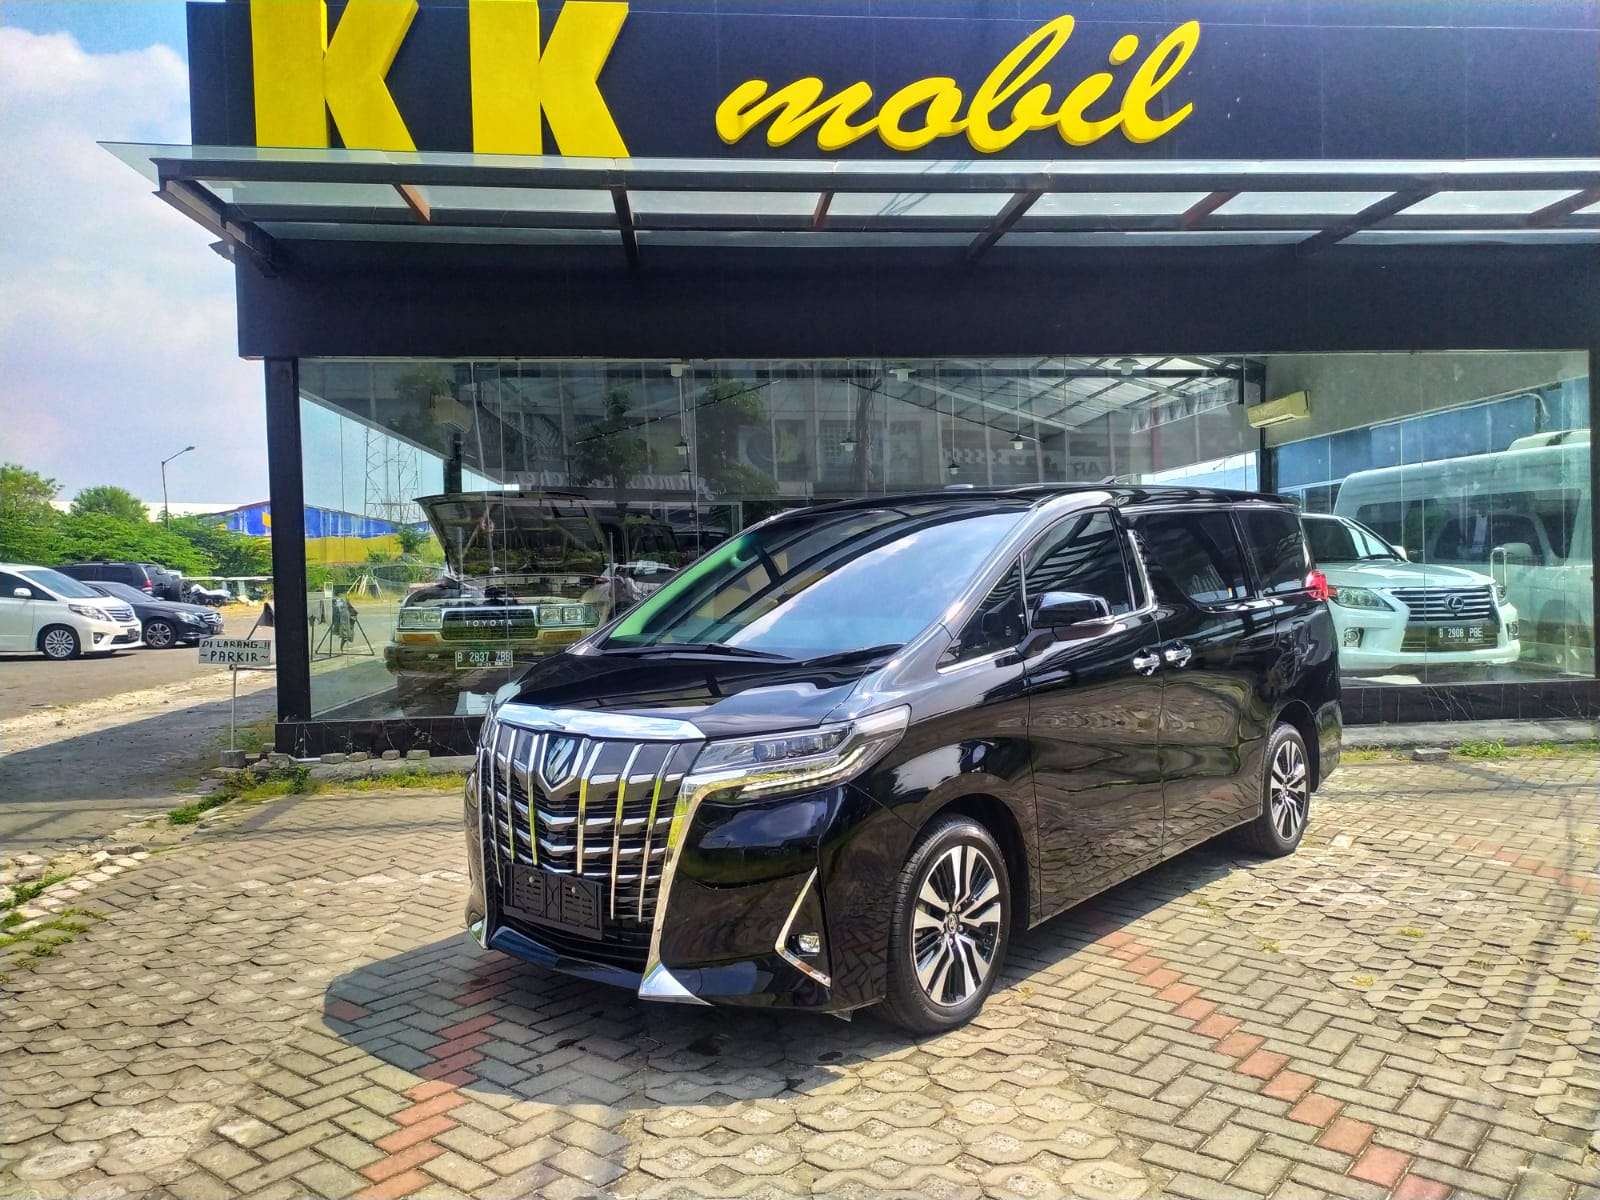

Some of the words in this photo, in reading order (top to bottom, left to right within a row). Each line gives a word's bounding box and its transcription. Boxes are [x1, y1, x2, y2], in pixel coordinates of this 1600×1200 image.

[715, 14, 1200, 154] mobil
[465, 619, 513, 627] TOYOTA
[202, 640, 213, 648] DI
[457, 652, 463, 662] B
[469, 651, 490, 662] 2837
